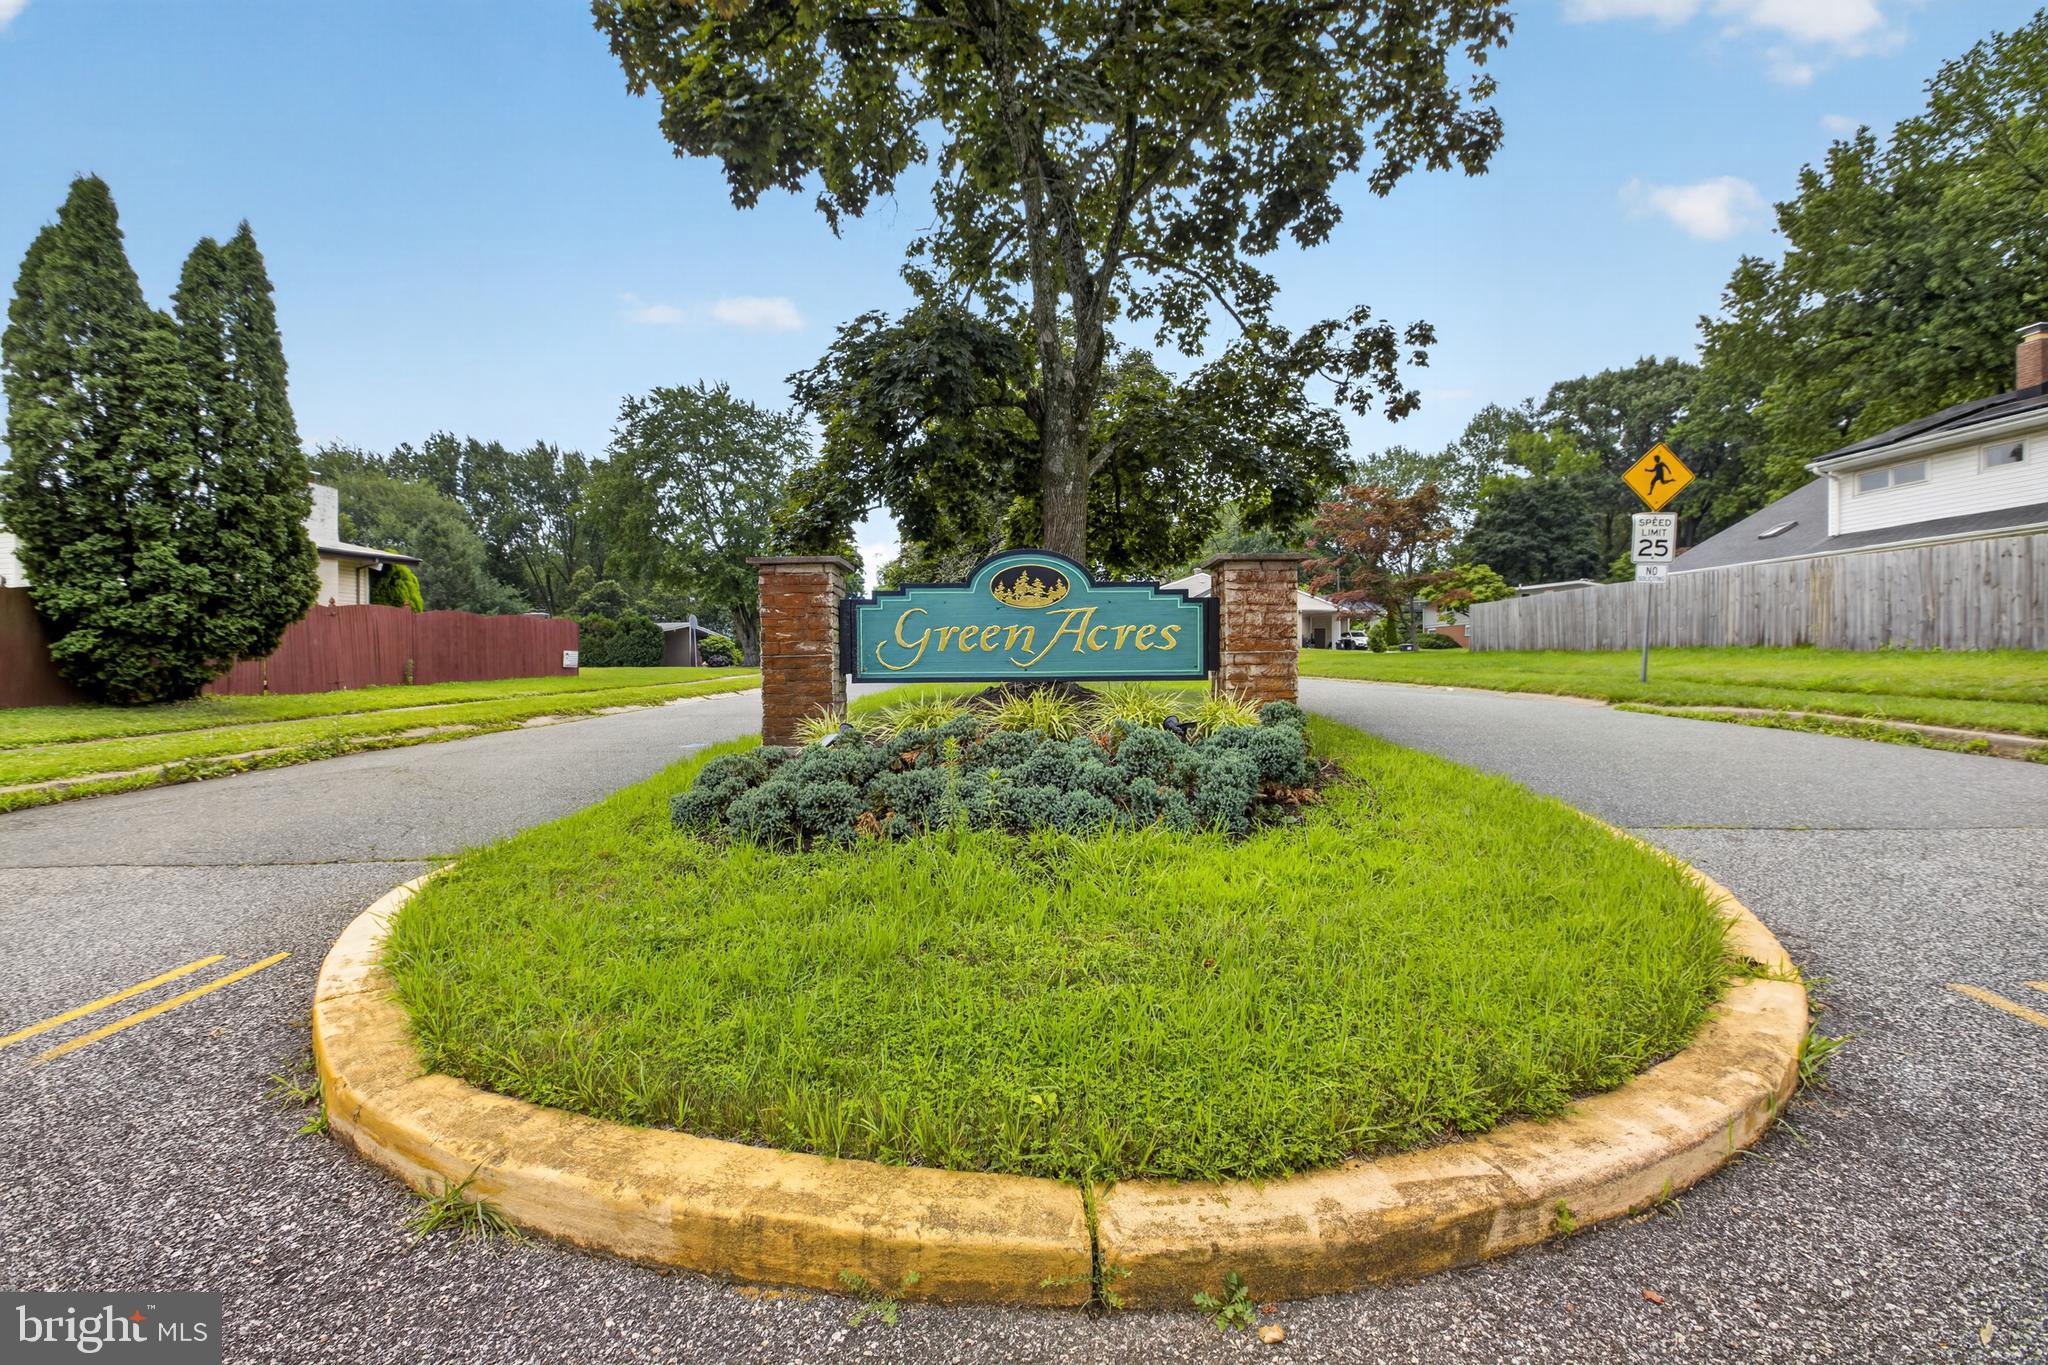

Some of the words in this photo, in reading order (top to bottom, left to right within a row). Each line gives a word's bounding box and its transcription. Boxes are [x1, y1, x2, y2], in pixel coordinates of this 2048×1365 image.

[1639, 518, 1671, 527] SPEED
[1641, 529, 1667, 537] LIMIT
[1638, 539, 1668, 557] 25
[1646, 566, 1658, 576] NO
[876, 608, 1035, 671] Green
[1010, 606, 1181, 668] Acres
